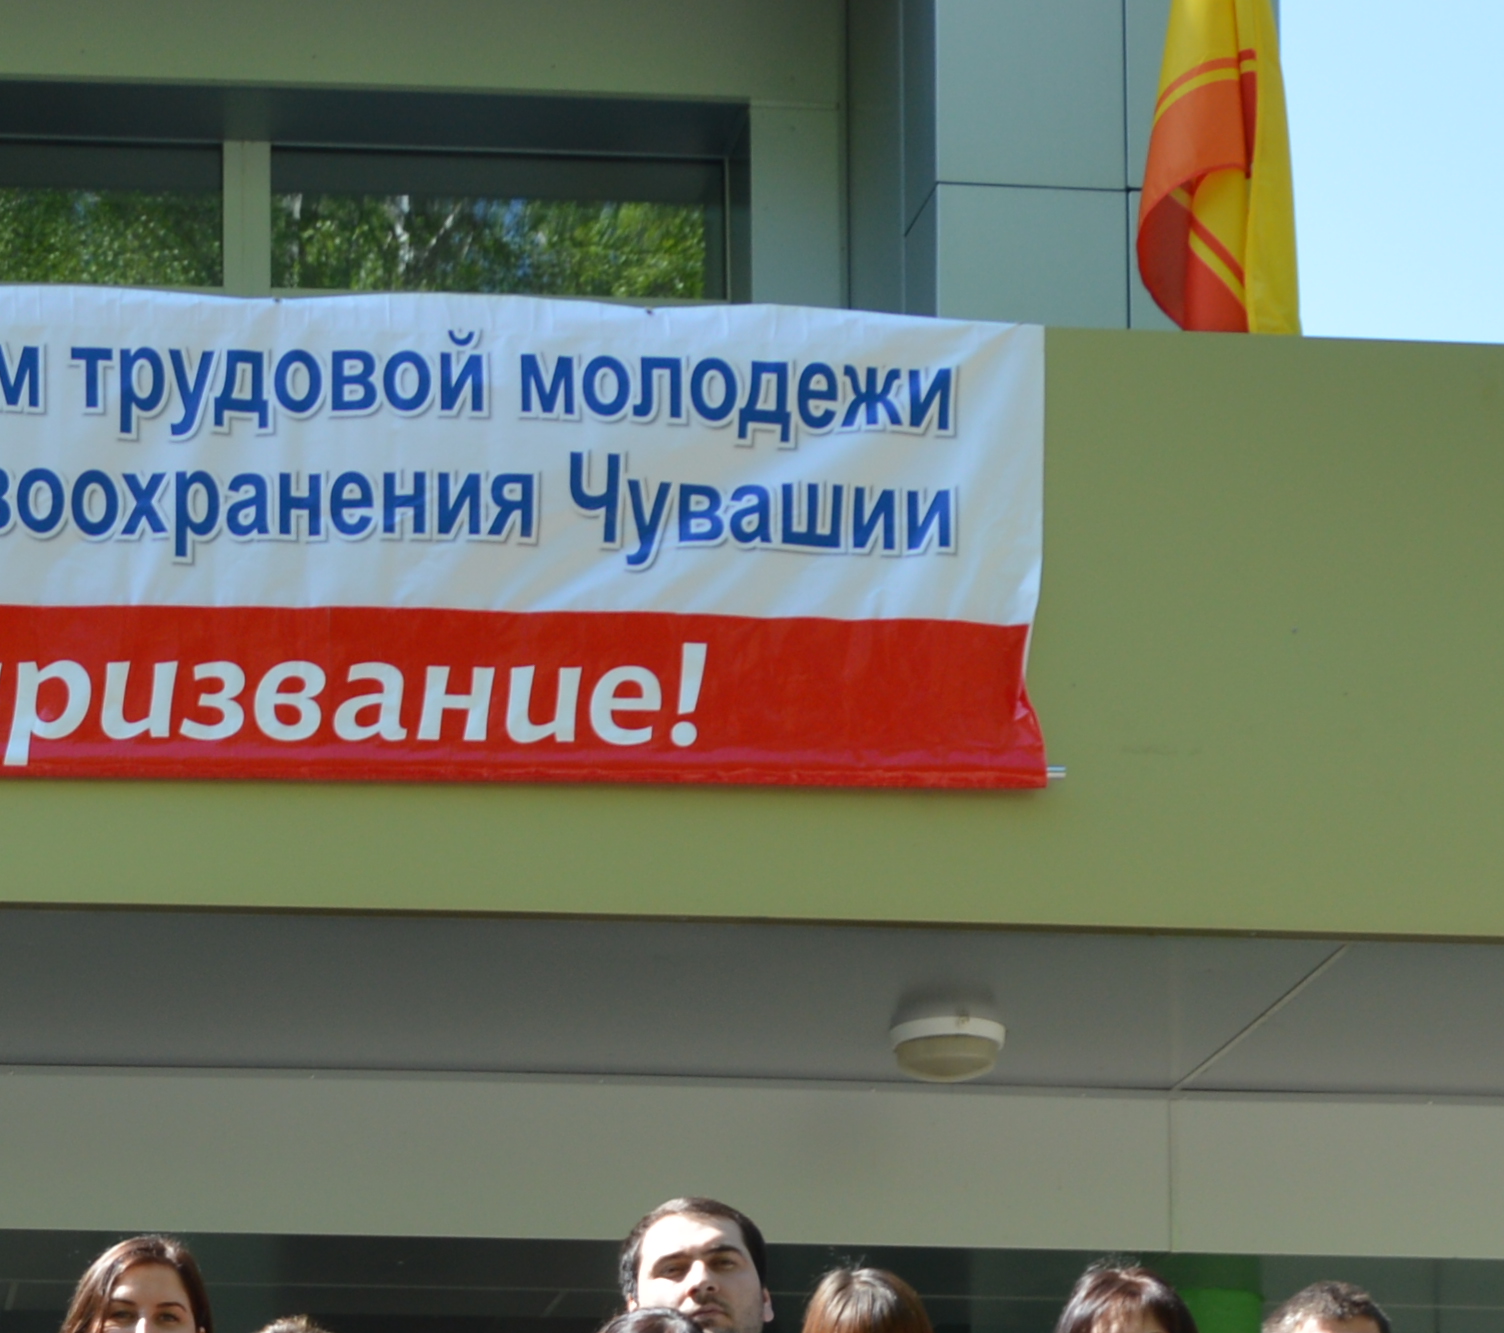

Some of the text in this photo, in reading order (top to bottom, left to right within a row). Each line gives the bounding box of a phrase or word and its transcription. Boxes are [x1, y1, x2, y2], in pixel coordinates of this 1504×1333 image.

[69, 328, 486, 437] трудовой
[519, 352, 954, 443] молодежи
[568, 449, 953, 567] Чувашии
